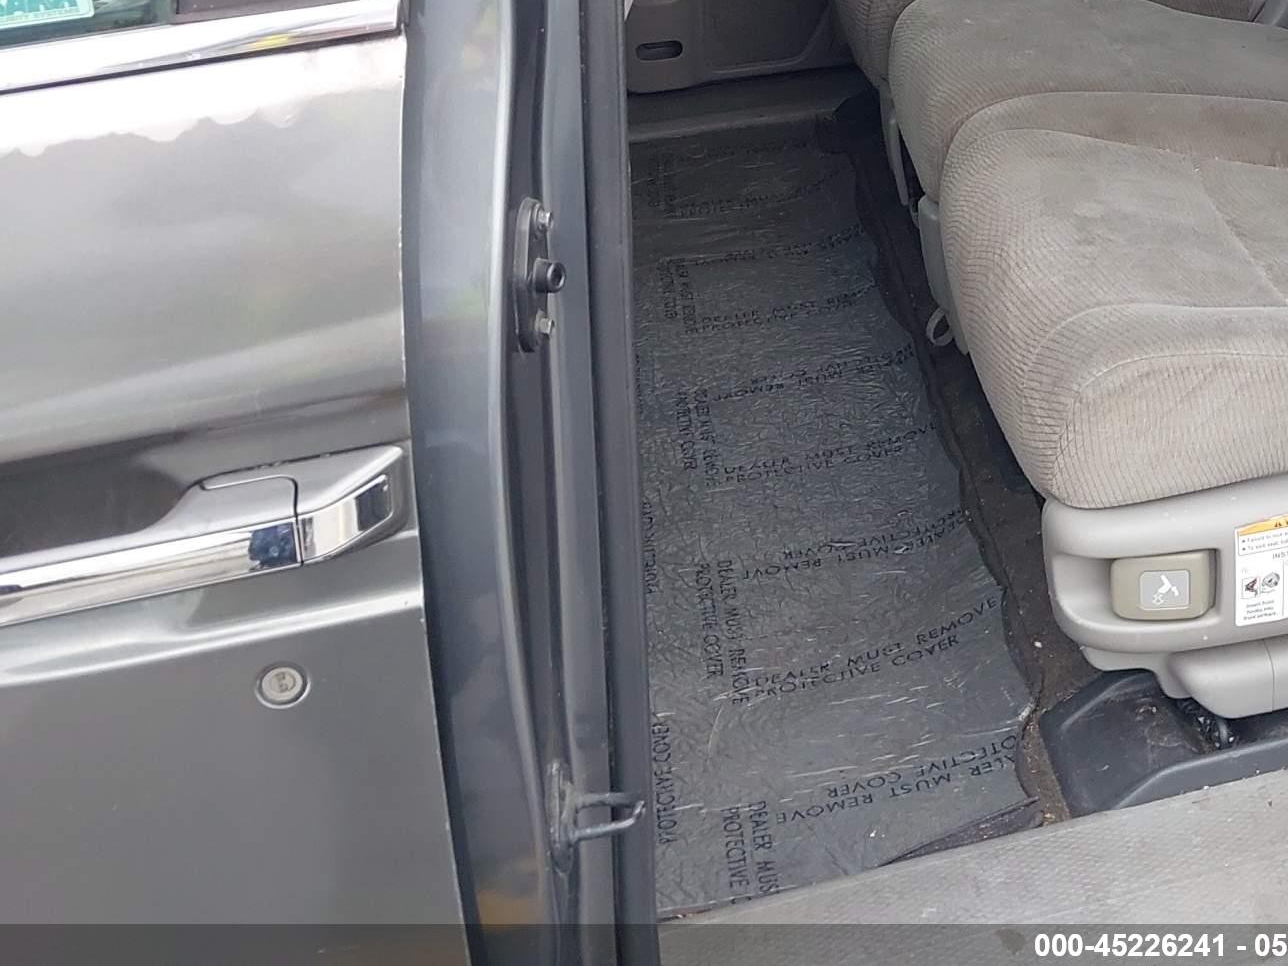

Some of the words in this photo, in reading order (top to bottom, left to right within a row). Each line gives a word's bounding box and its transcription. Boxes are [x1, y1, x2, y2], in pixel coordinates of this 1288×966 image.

[916, 596, 998, 645] REMOVE
[891, 634, 959, 666] COVER
[827, 770, 902, 799] COVER
[888, 772, 952, 799] MUST
[776, 793, 873, 824] REMOVE
[748, 800, 774, 851] DEALER
[721, 807, 750, 888] PROTECTIVE
